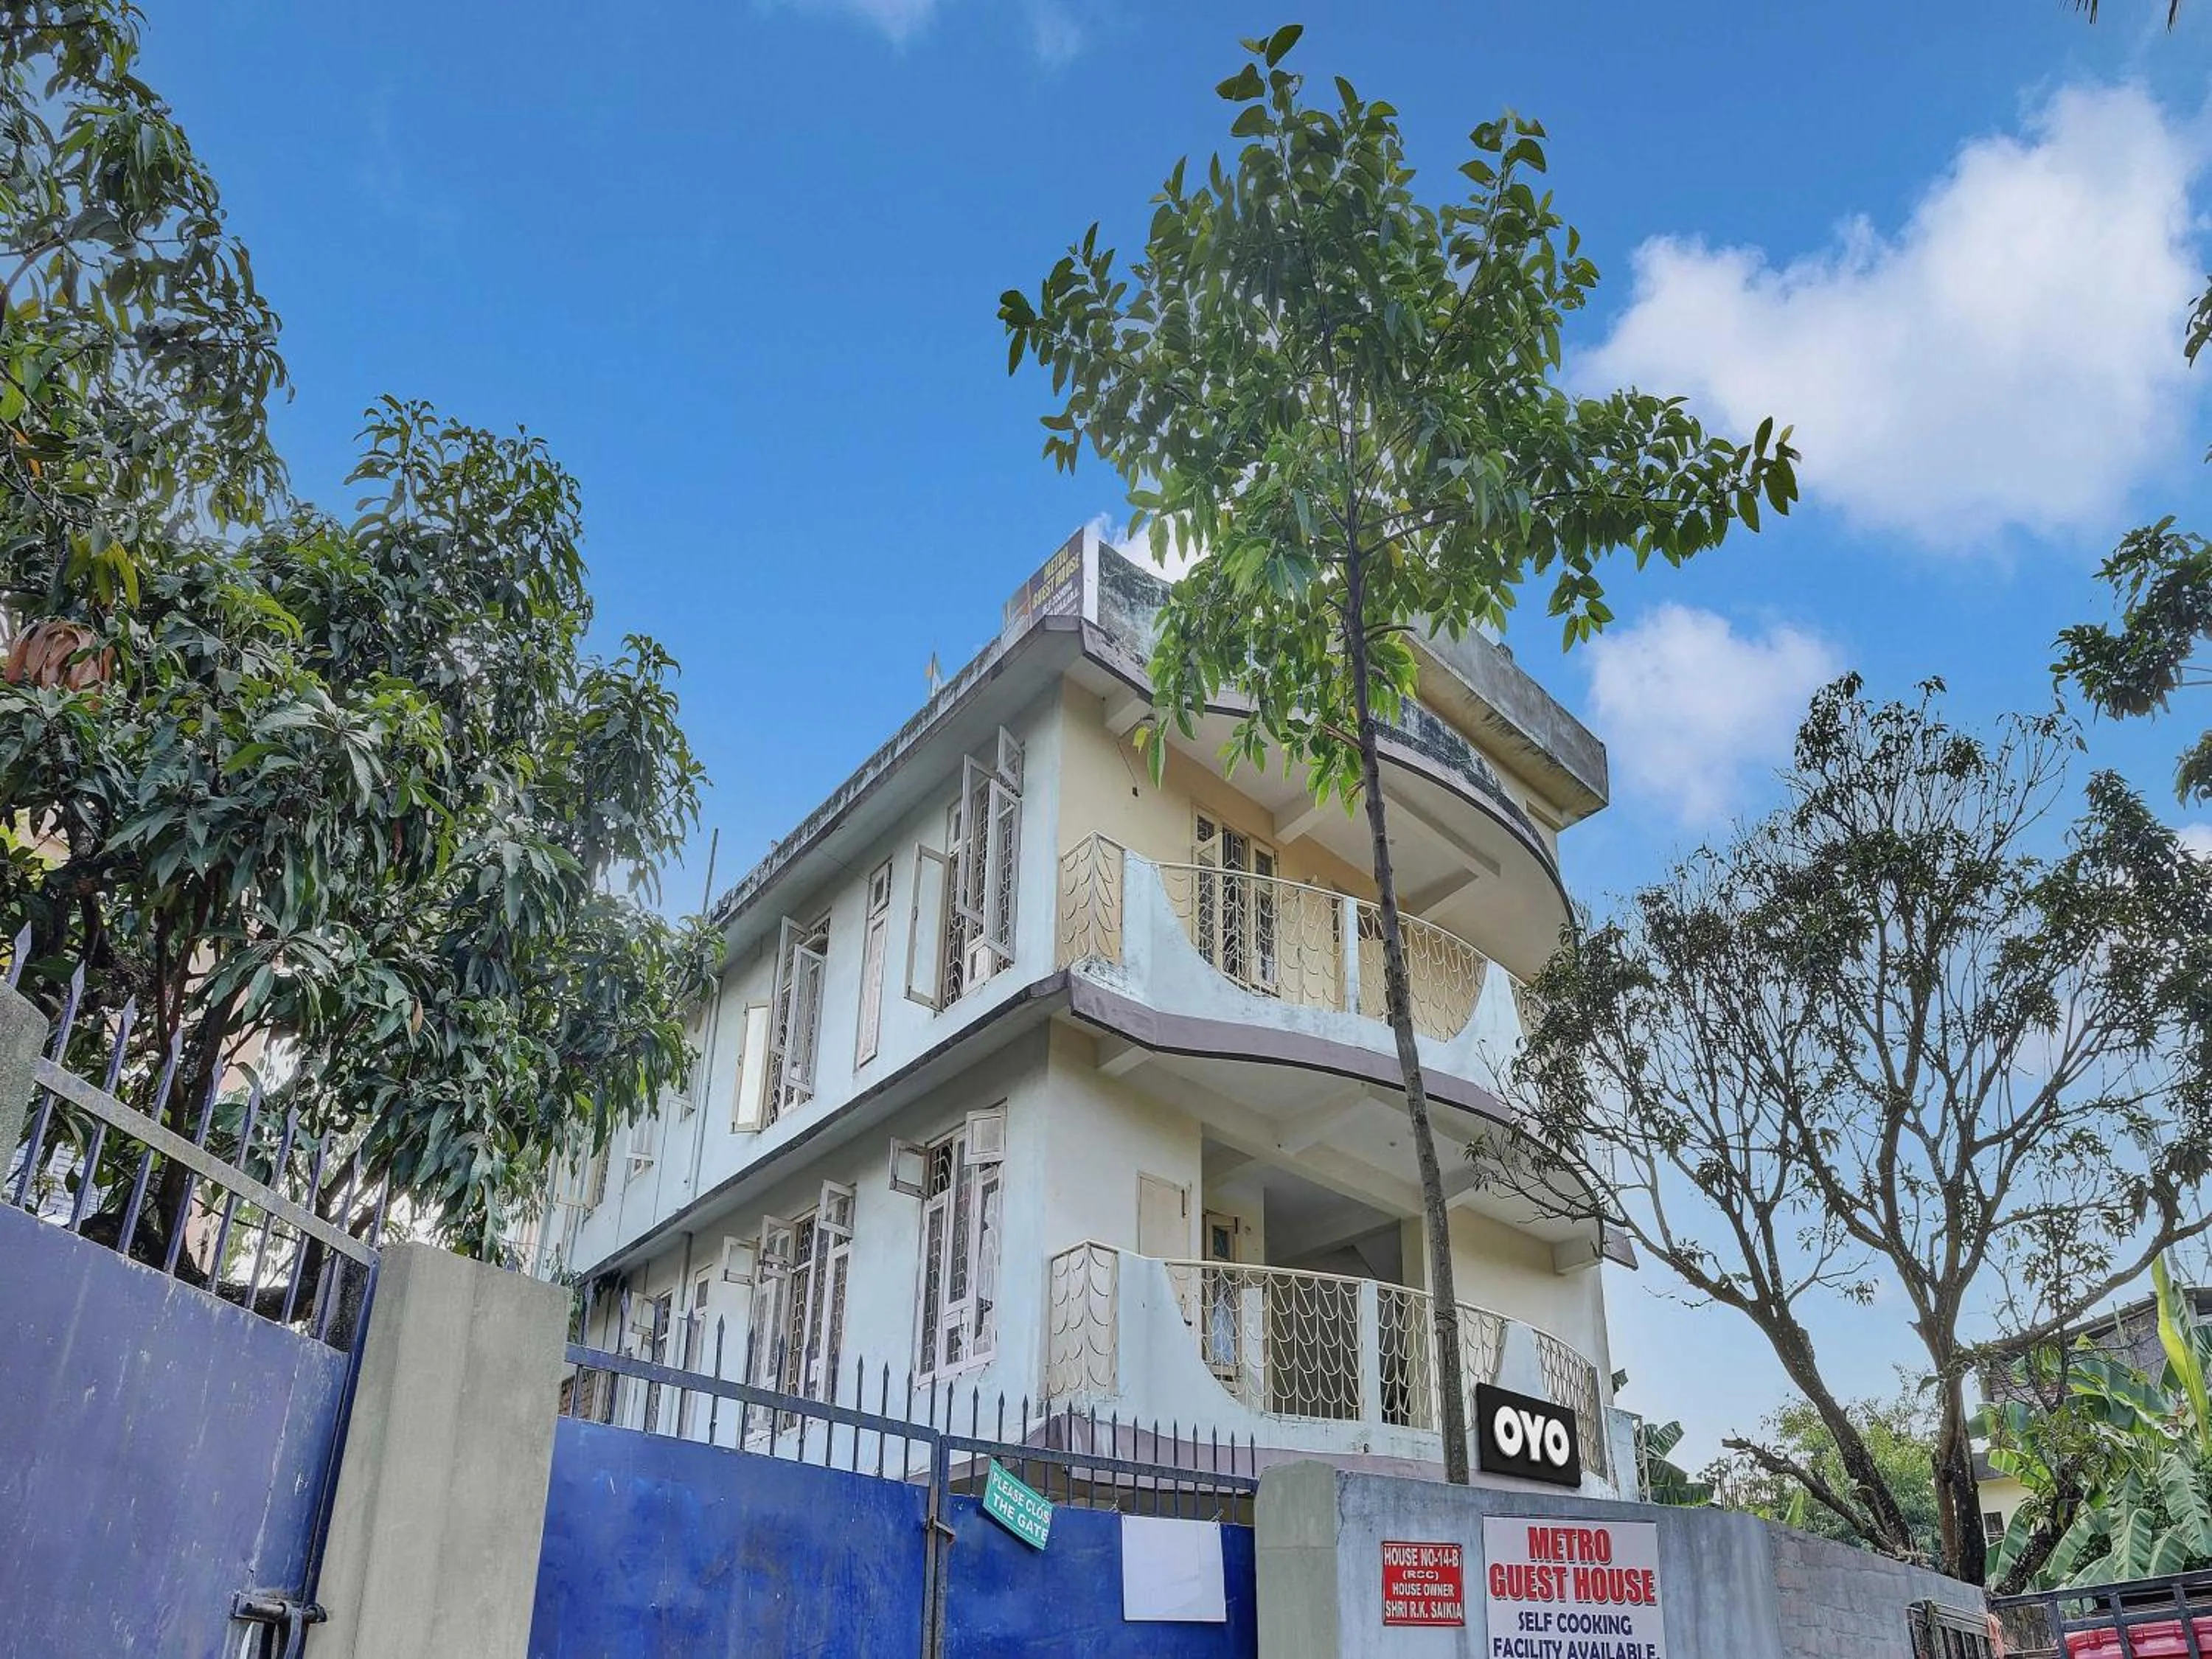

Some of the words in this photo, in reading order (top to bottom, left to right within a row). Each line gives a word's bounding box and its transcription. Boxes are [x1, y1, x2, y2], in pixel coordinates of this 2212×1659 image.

[1494, 1405, 1570, 1467] OYO
[992, 1472, 1025, 1507] PLEASE
[993, 1492, 1015, 1520] THE
[1018, 1513, 1048, 1543] GATE
[1384, 1547, 1418, 1567] HOUSE
[1528, 1526, 1612, 1565] METRO
[1402, 1570, 1439, 1581] (RCC)
[1489, 1563, 1568, 1602] GUEST
[1573, 1567, 1657, 1606] HOUSE
[1392, 1582, 1422, 1596] HOUSE
[1423, 1583, 1455, 1597] OWNER
[1385, 1600, 1408, 1618] SHRI
[1518, 1612, 1552, 1632] SELF
[1557, 1613, 1632, 1635] COOKING
[1493, 1638, 1562, 1659] FACILITY
